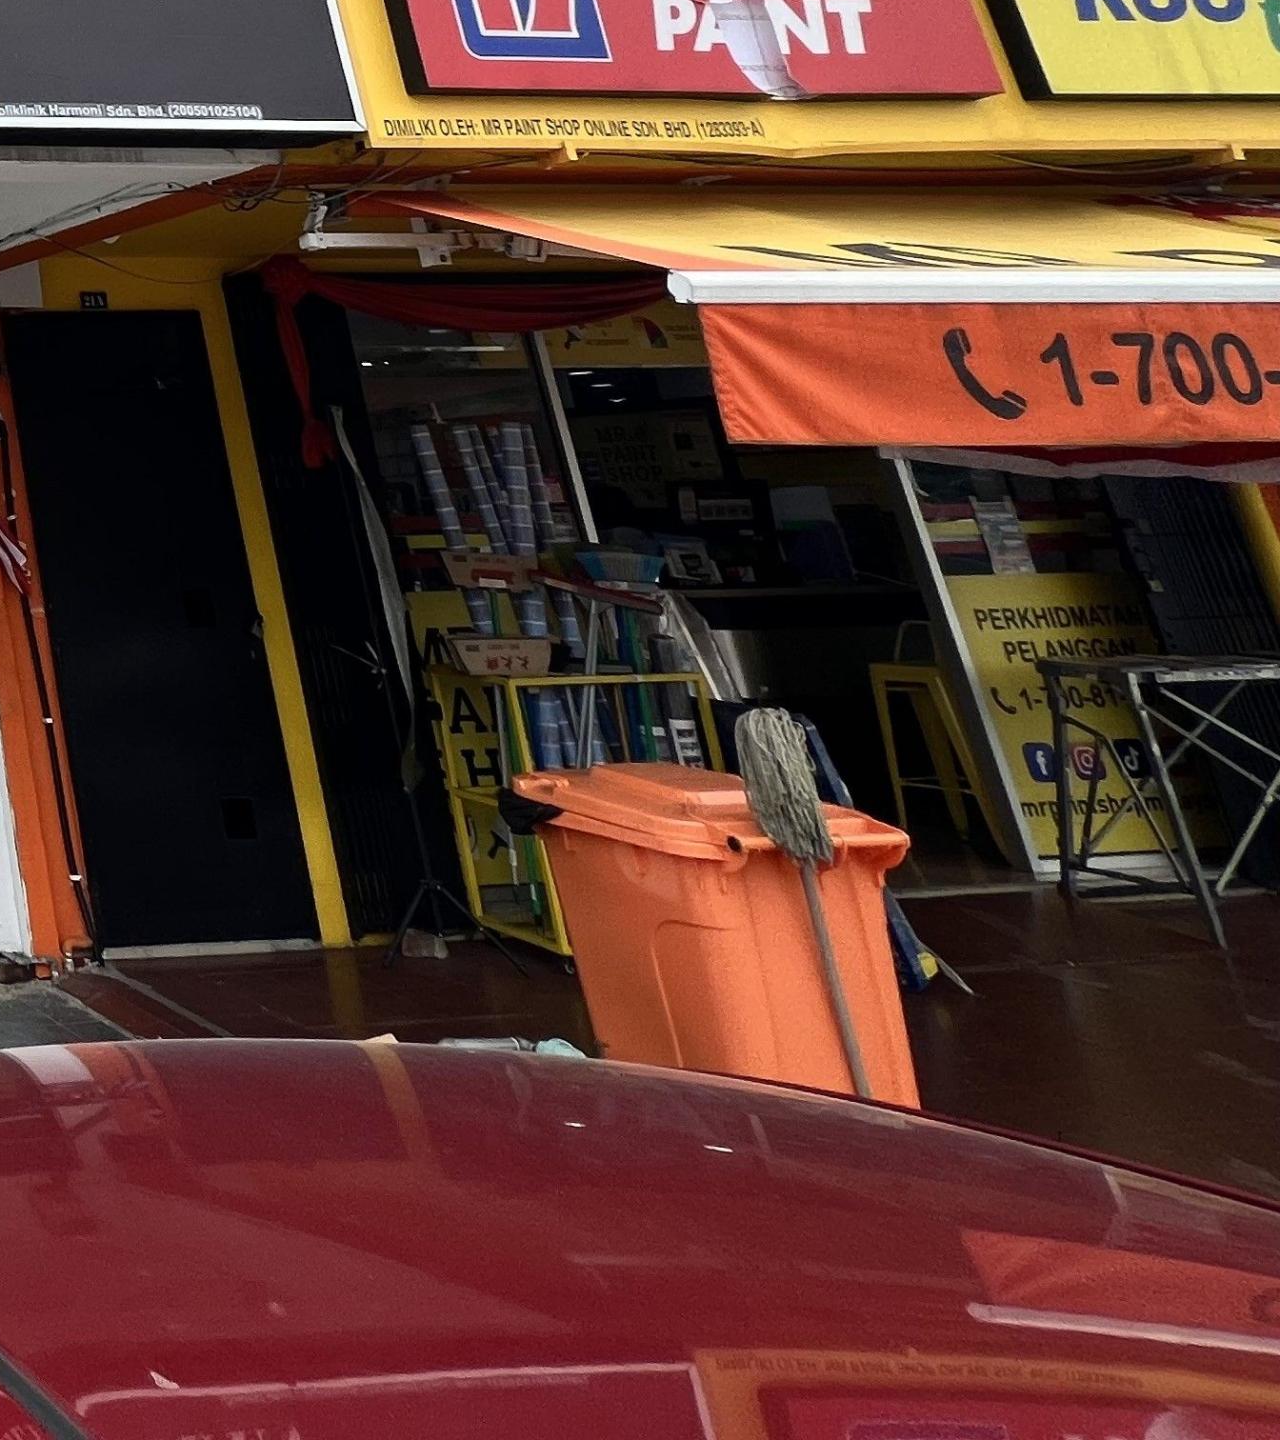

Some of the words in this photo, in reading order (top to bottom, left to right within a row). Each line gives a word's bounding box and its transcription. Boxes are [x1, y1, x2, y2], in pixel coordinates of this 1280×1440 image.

[49, 105, 103, 117] Harmoni
[106, 105, 135, 118] Sdn.
[137, 106, 166, 118] Bhd.
[384, 118, 436, 137] DIMILIKI
[440, 118, 479, 137] OLEH:
[481, 118, 502, 137] MR
[505, 118, 541, 137] PAINT
[546, 118, 580, 137] SHOP
[585, 118, 630, 137] ONLINE
[633, 118, 662, 137] SDN.
[665, 118, 694, 137] BHD.
